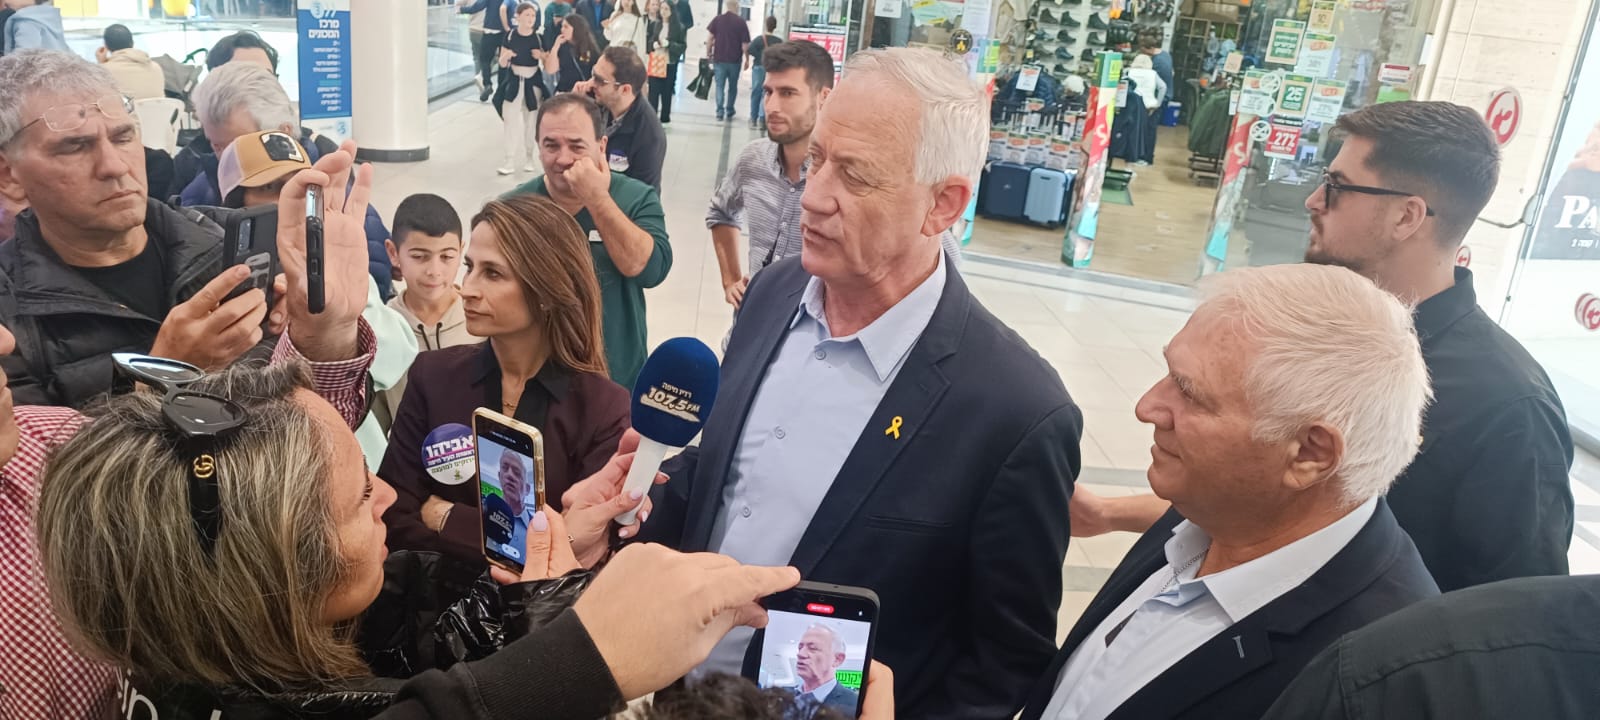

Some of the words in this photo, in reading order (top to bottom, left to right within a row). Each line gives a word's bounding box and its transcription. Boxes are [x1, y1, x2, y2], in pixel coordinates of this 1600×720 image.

[1286, 86, 1304, 102] 25
[662, 382, 679, 394] חיפה
[679, 389, 692, 399] רדיו
[426, 435, 474, 458] אביהו
